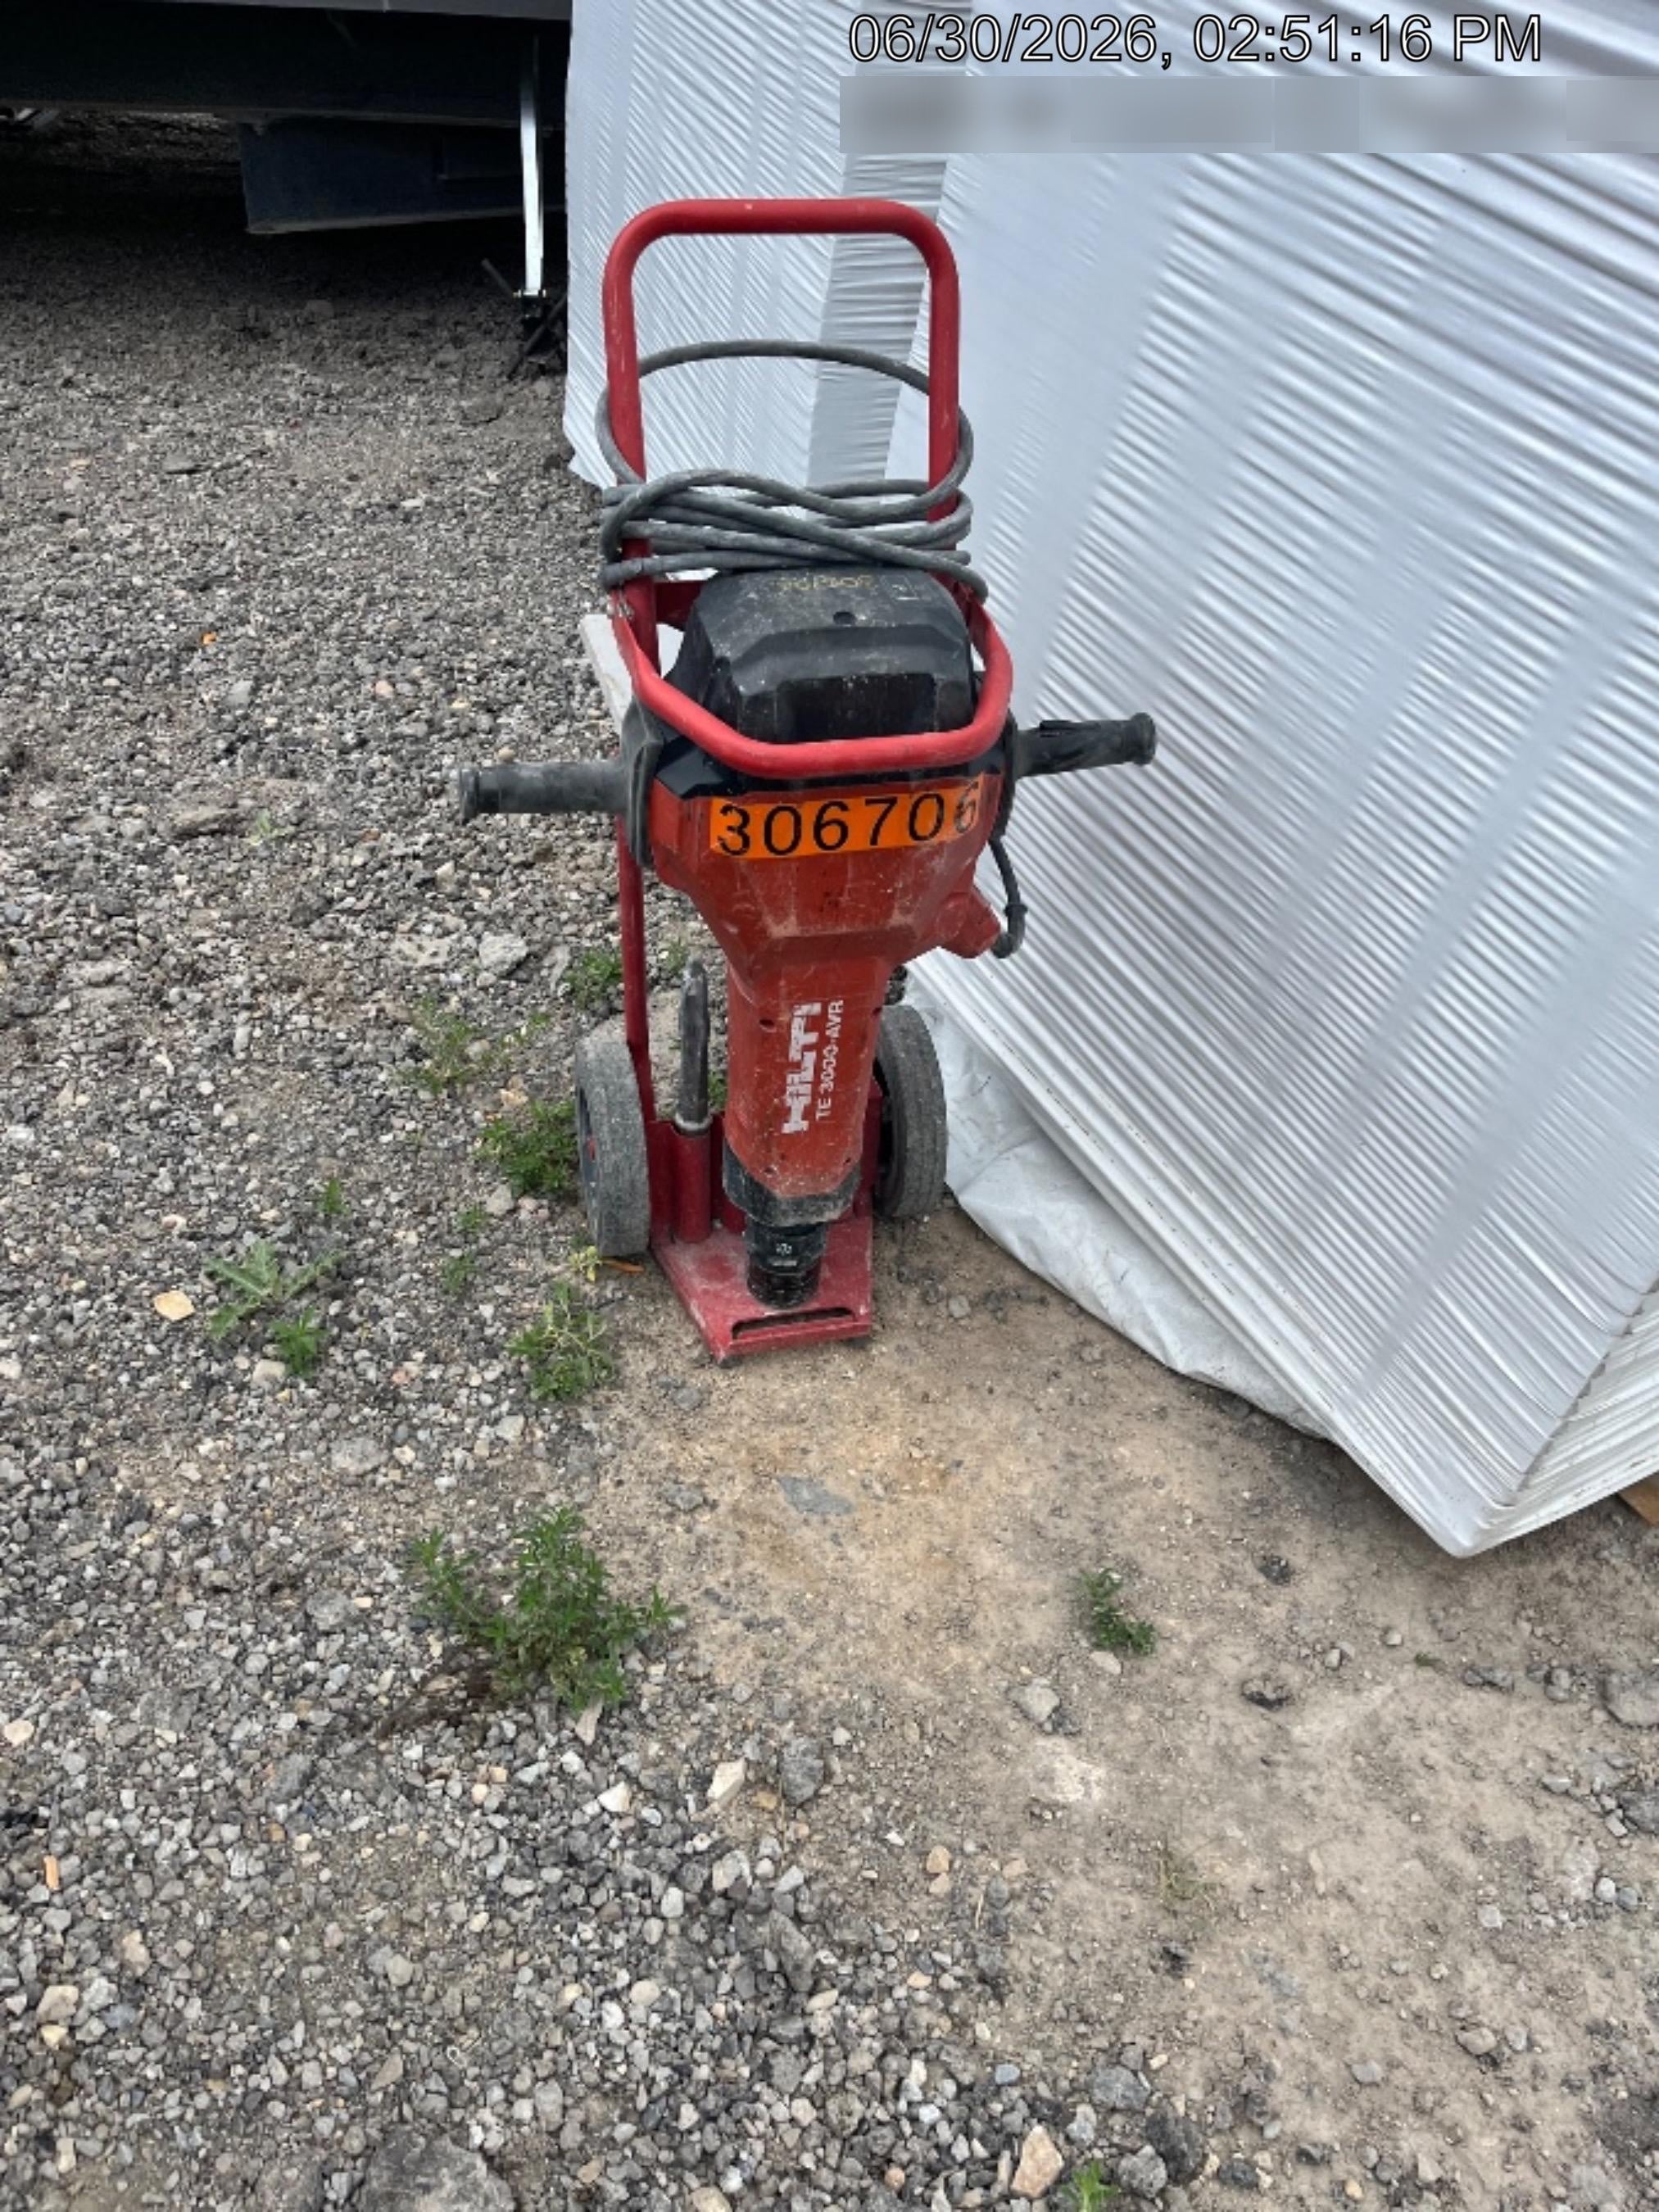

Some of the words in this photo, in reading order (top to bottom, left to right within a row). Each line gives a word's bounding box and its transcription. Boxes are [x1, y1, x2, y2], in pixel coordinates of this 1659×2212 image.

[717, 781, 979, 857] 306706
[782, 1002, 822, 1134] HILTI
[820, 999, 845, 1094] 3000-AVR
[815, 1097, 832, 1121] TE
